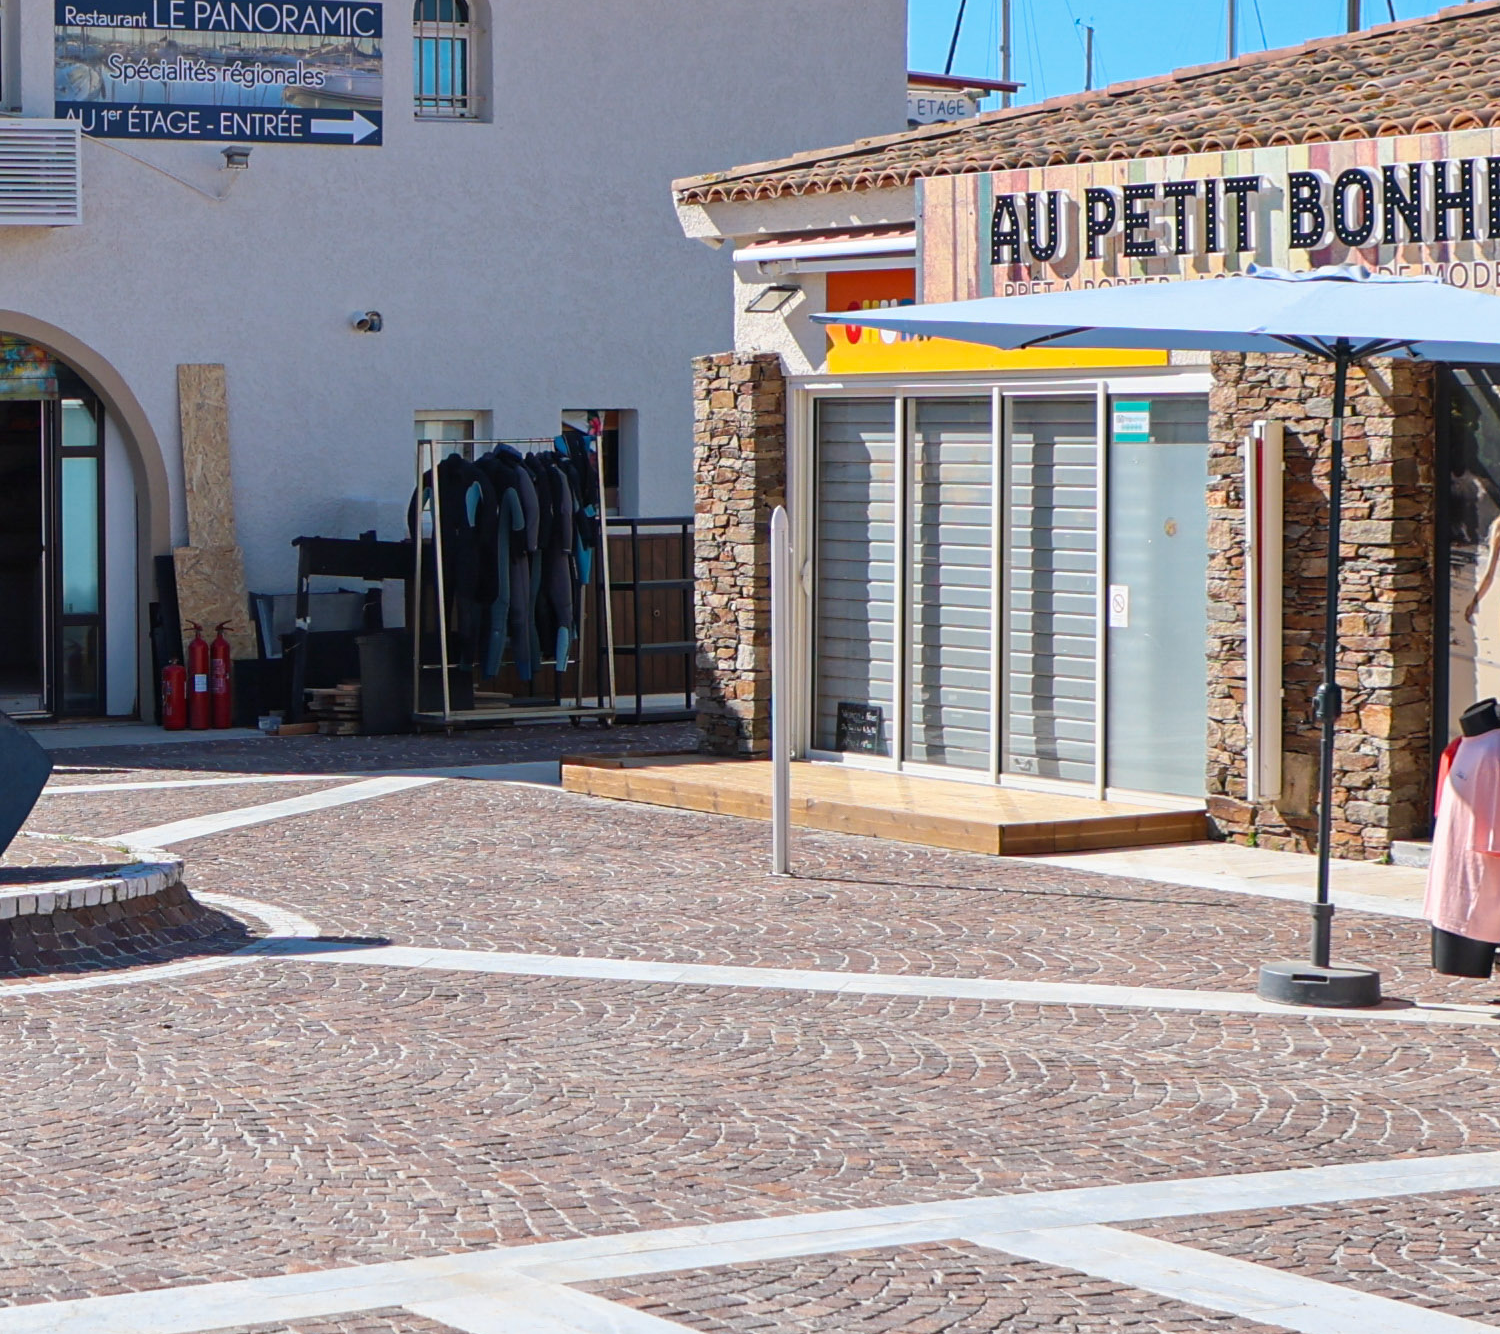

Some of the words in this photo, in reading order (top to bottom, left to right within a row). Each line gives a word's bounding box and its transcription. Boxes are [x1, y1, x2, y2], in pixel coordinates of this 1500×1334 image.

[65, 5, 148, 28] Restaurant
[194, 0, 376, 37] PANORAMIC
[108, 53, 217, 86] Spécialités
[222, 61, 325, 88] régionales
[128, 105, 201, 134] ÉTAGE
[220, 110, 303, 137] ENTRÉE
[917, 98, 965, 116] ETAGE
[990, 190, 1064, 265] AU
[1084, 175, 1262, 260] PETIT
